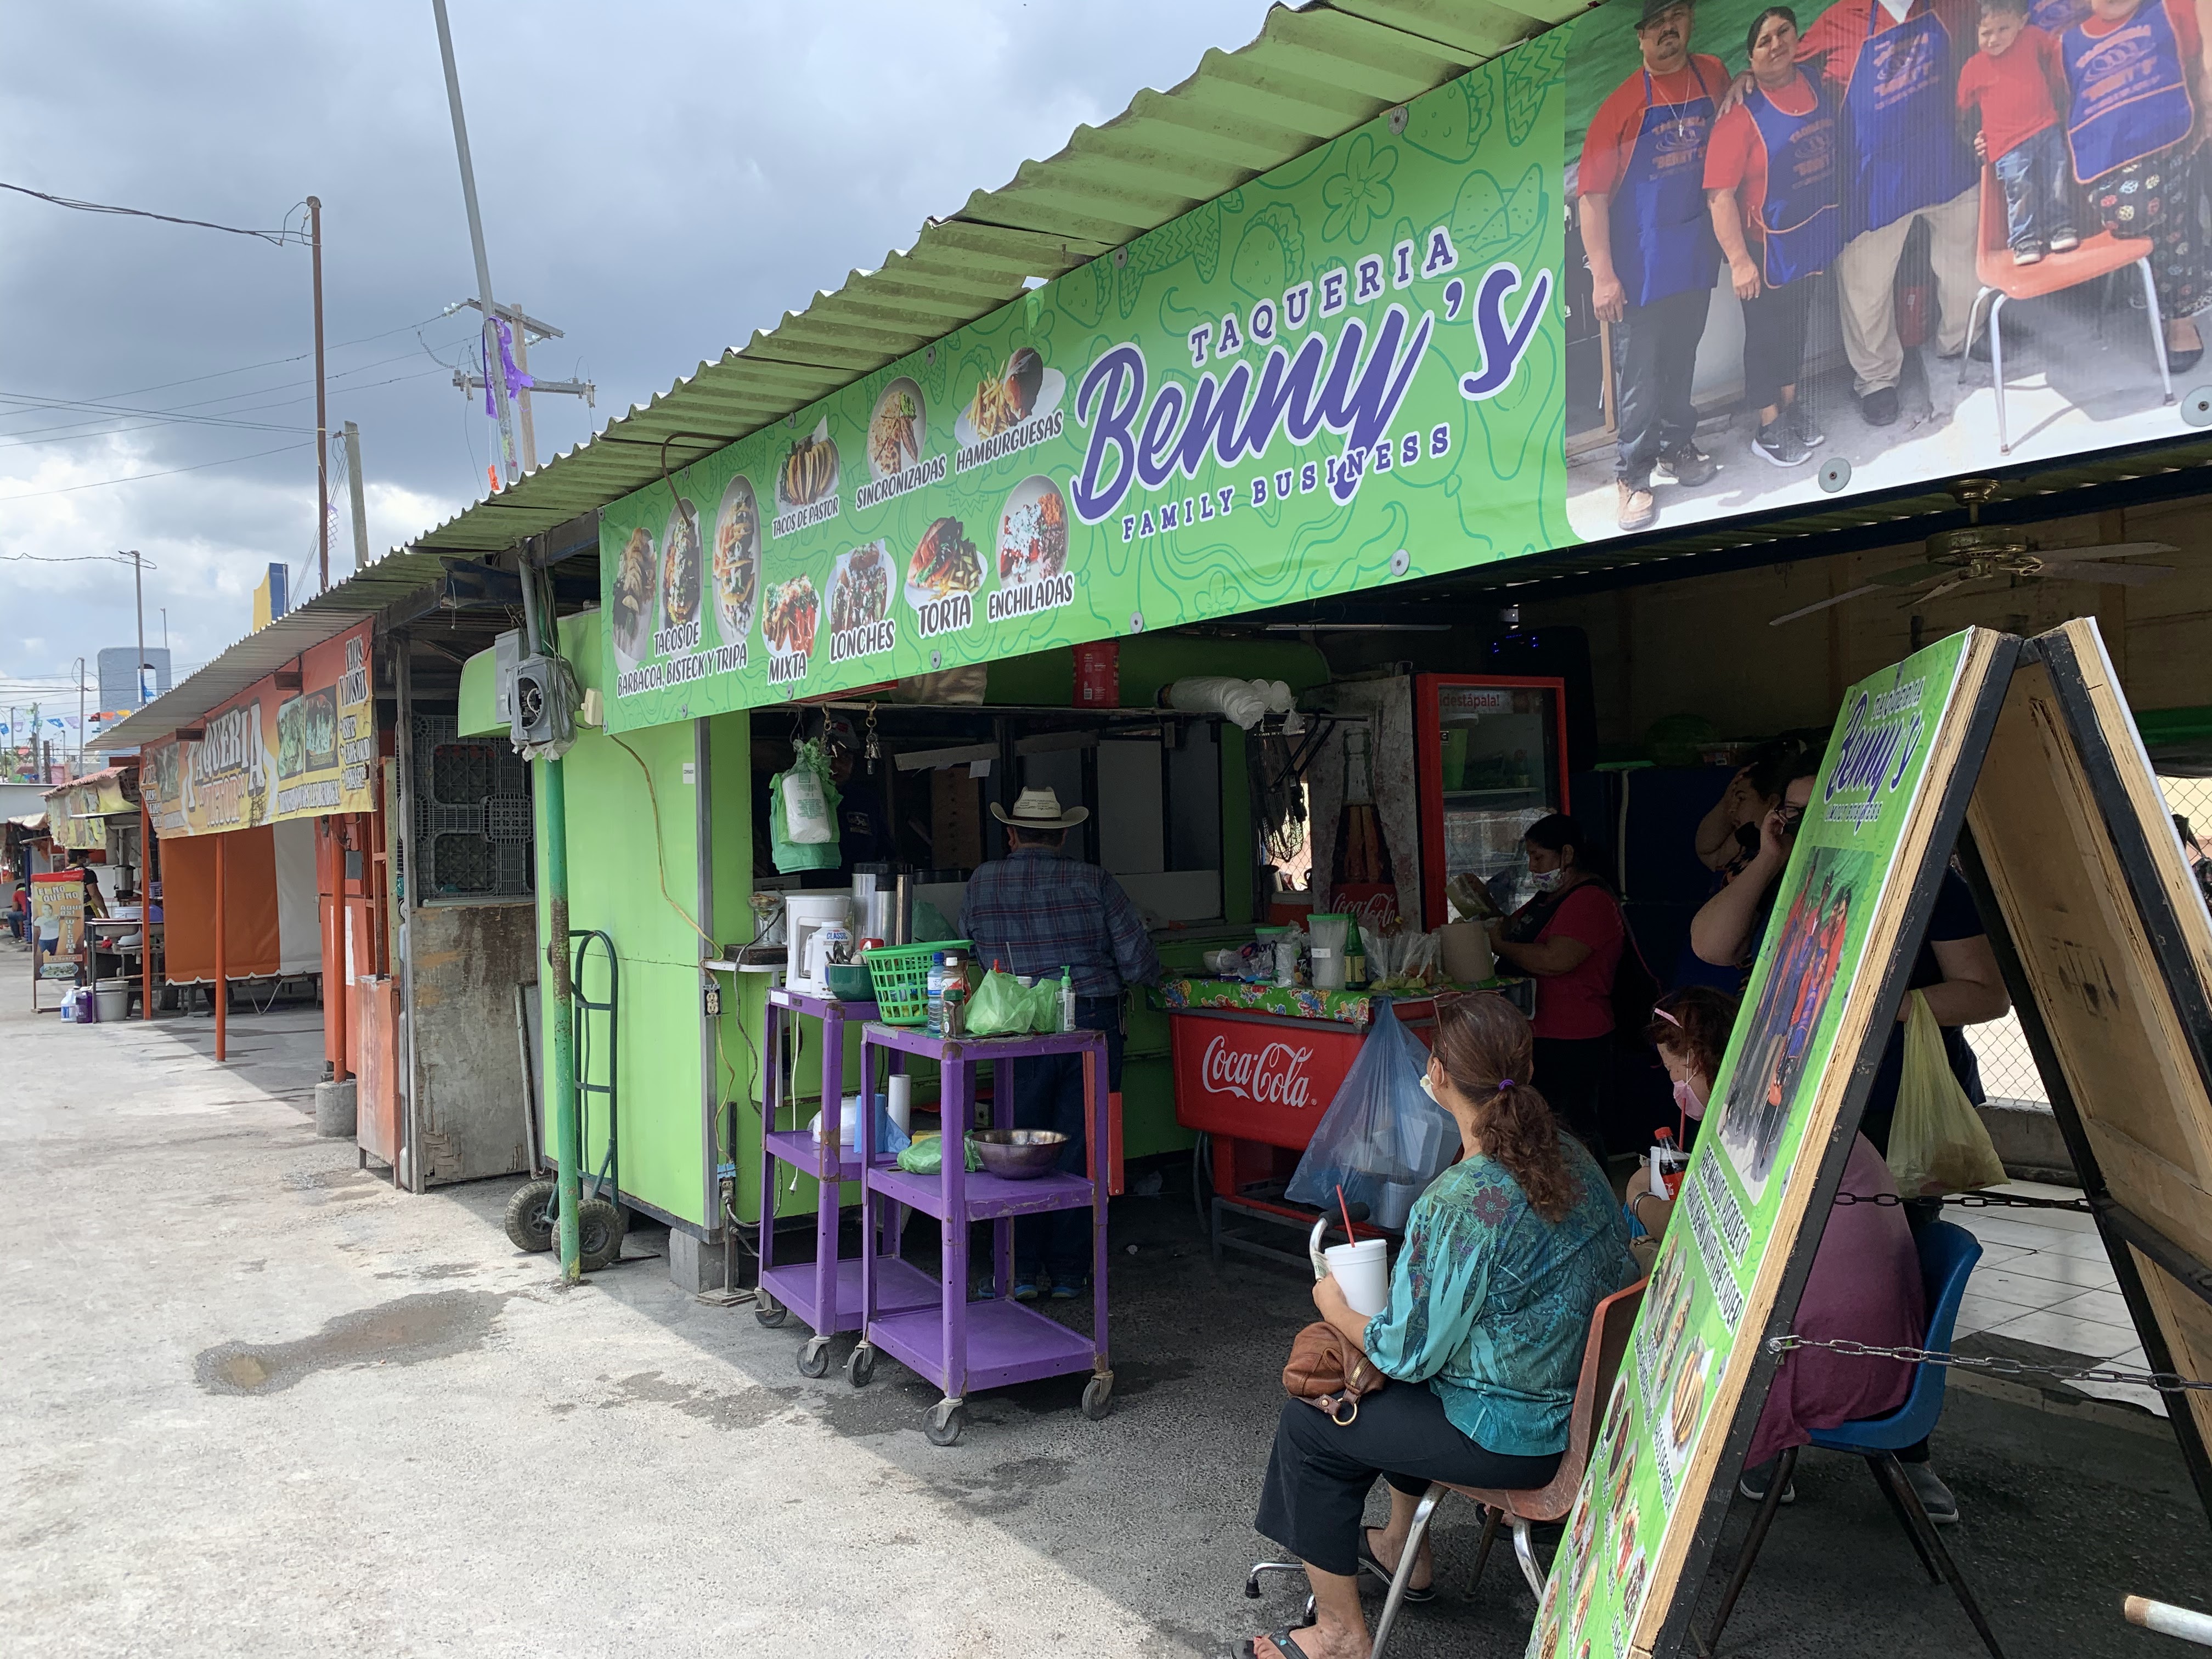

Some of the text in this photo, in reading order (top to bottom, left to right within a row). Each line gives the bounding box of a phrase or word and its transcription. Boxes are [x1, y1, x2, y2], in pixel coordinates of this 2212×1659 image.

[1190, 232, 1455, 362] TAQUERIA
[1073, 267, 1548, 521] Benny's
[956, 411, 1063, 472] HAMBURGUESAS
[856, 455, 946, 509] SINCRONIZADAS
[1123, 427, 1450, 539] FAMILY BUSINESS
[772, 496, 839, 537] TACOS DE PASTOR
[918, 594, 973, 635] TORTA
[989, 574, 1074, 619] ENCHILADAS
[654, 622, 699, 655] TACOS DE
[830, 620, 895, 662] LONCHES
[617, 642, 747, 697] BARBACOA, BISTECK Y TRIPA
[768, 651, 806, 685] MIXTA
[1871, 676, 1925, 721] TAQUERIA
[185, 703, 266, 808] TAQUERIA
[1202, 1035, 1313, 1108] Coca-Cola
[1720, 1192, 1743, 1251] POZOLE
[1735, 1222, 1750, 1265] OR
[1692, 1198, 1709, 1246] BEANS
[1702, 1225, 1718, 1272] WITH
[1711, 1248, 1726, 1293] THE
[1719, 1269, 1743, 1335] ORDER
